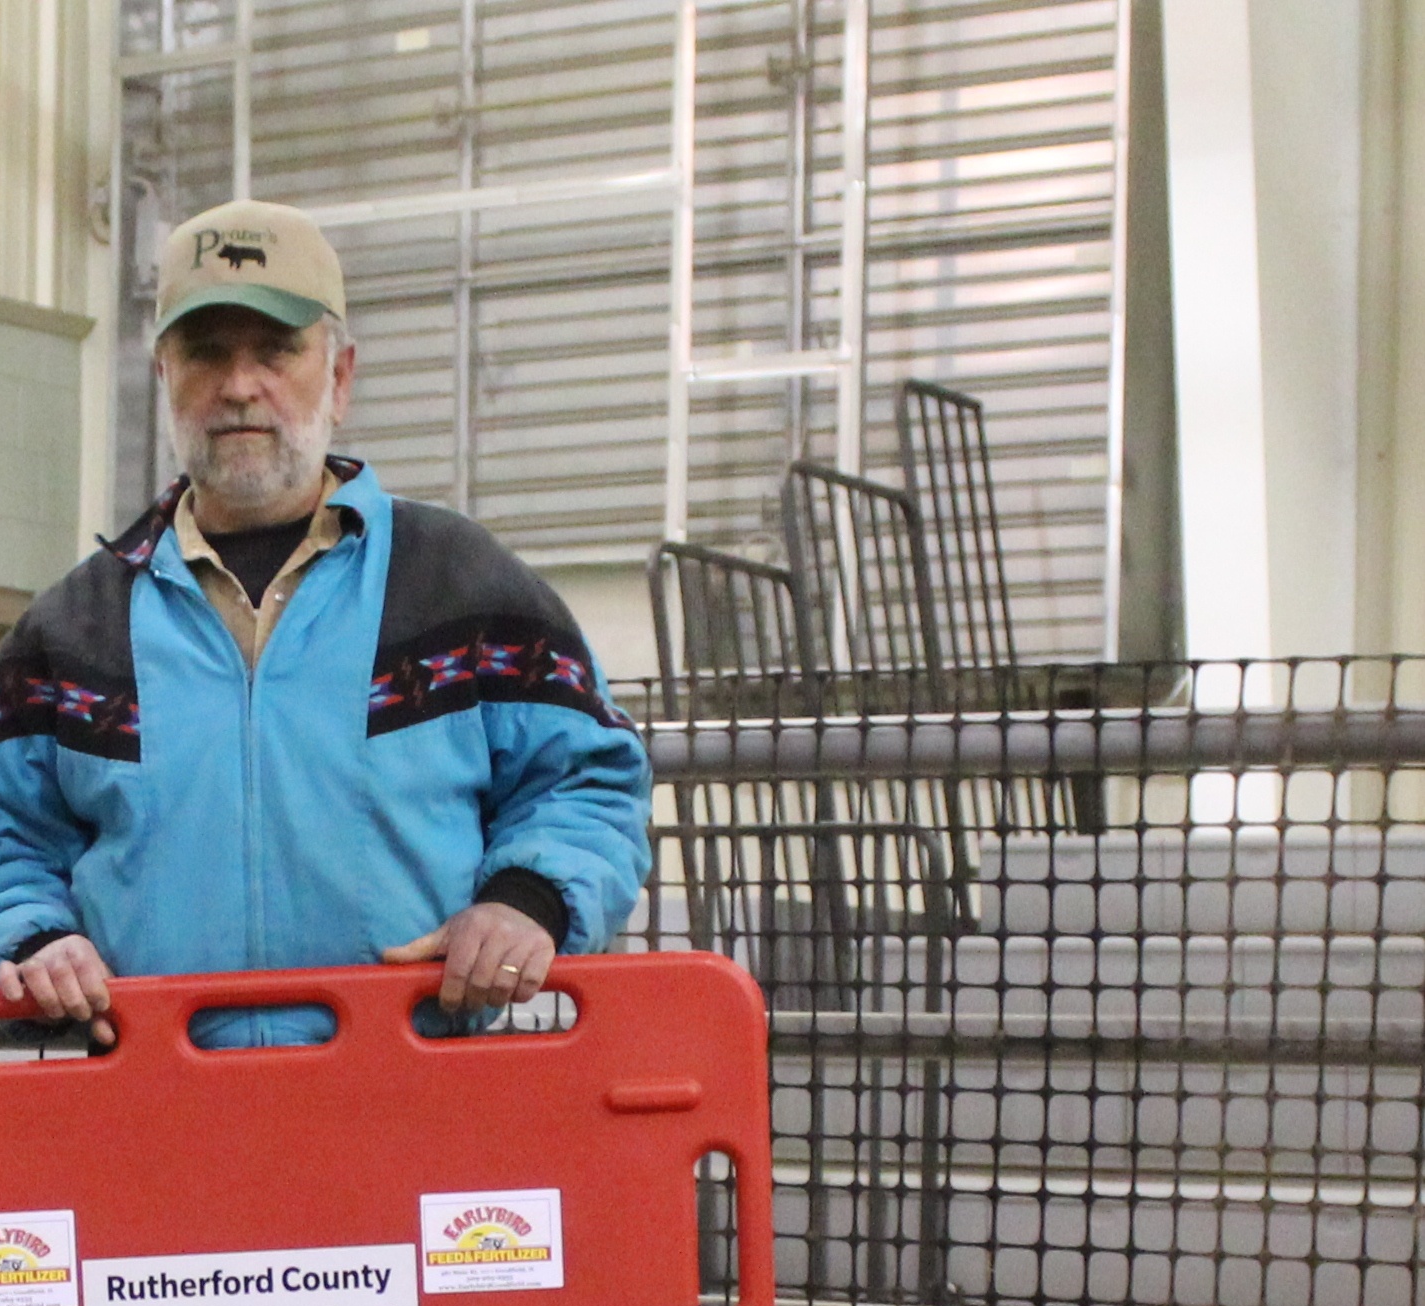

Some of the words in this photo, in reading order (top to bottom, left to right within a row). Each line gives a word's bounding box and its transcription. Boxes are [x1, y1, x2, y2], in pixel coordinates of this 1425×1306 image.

[443, 1206, 532, 1241] EARLYBIRD
[429, 1248, 548, 1264] FEED&FERTILIZER
[107, 1268, 274, 1301] Rutherford
[281, 1265, 391, 1294] County
